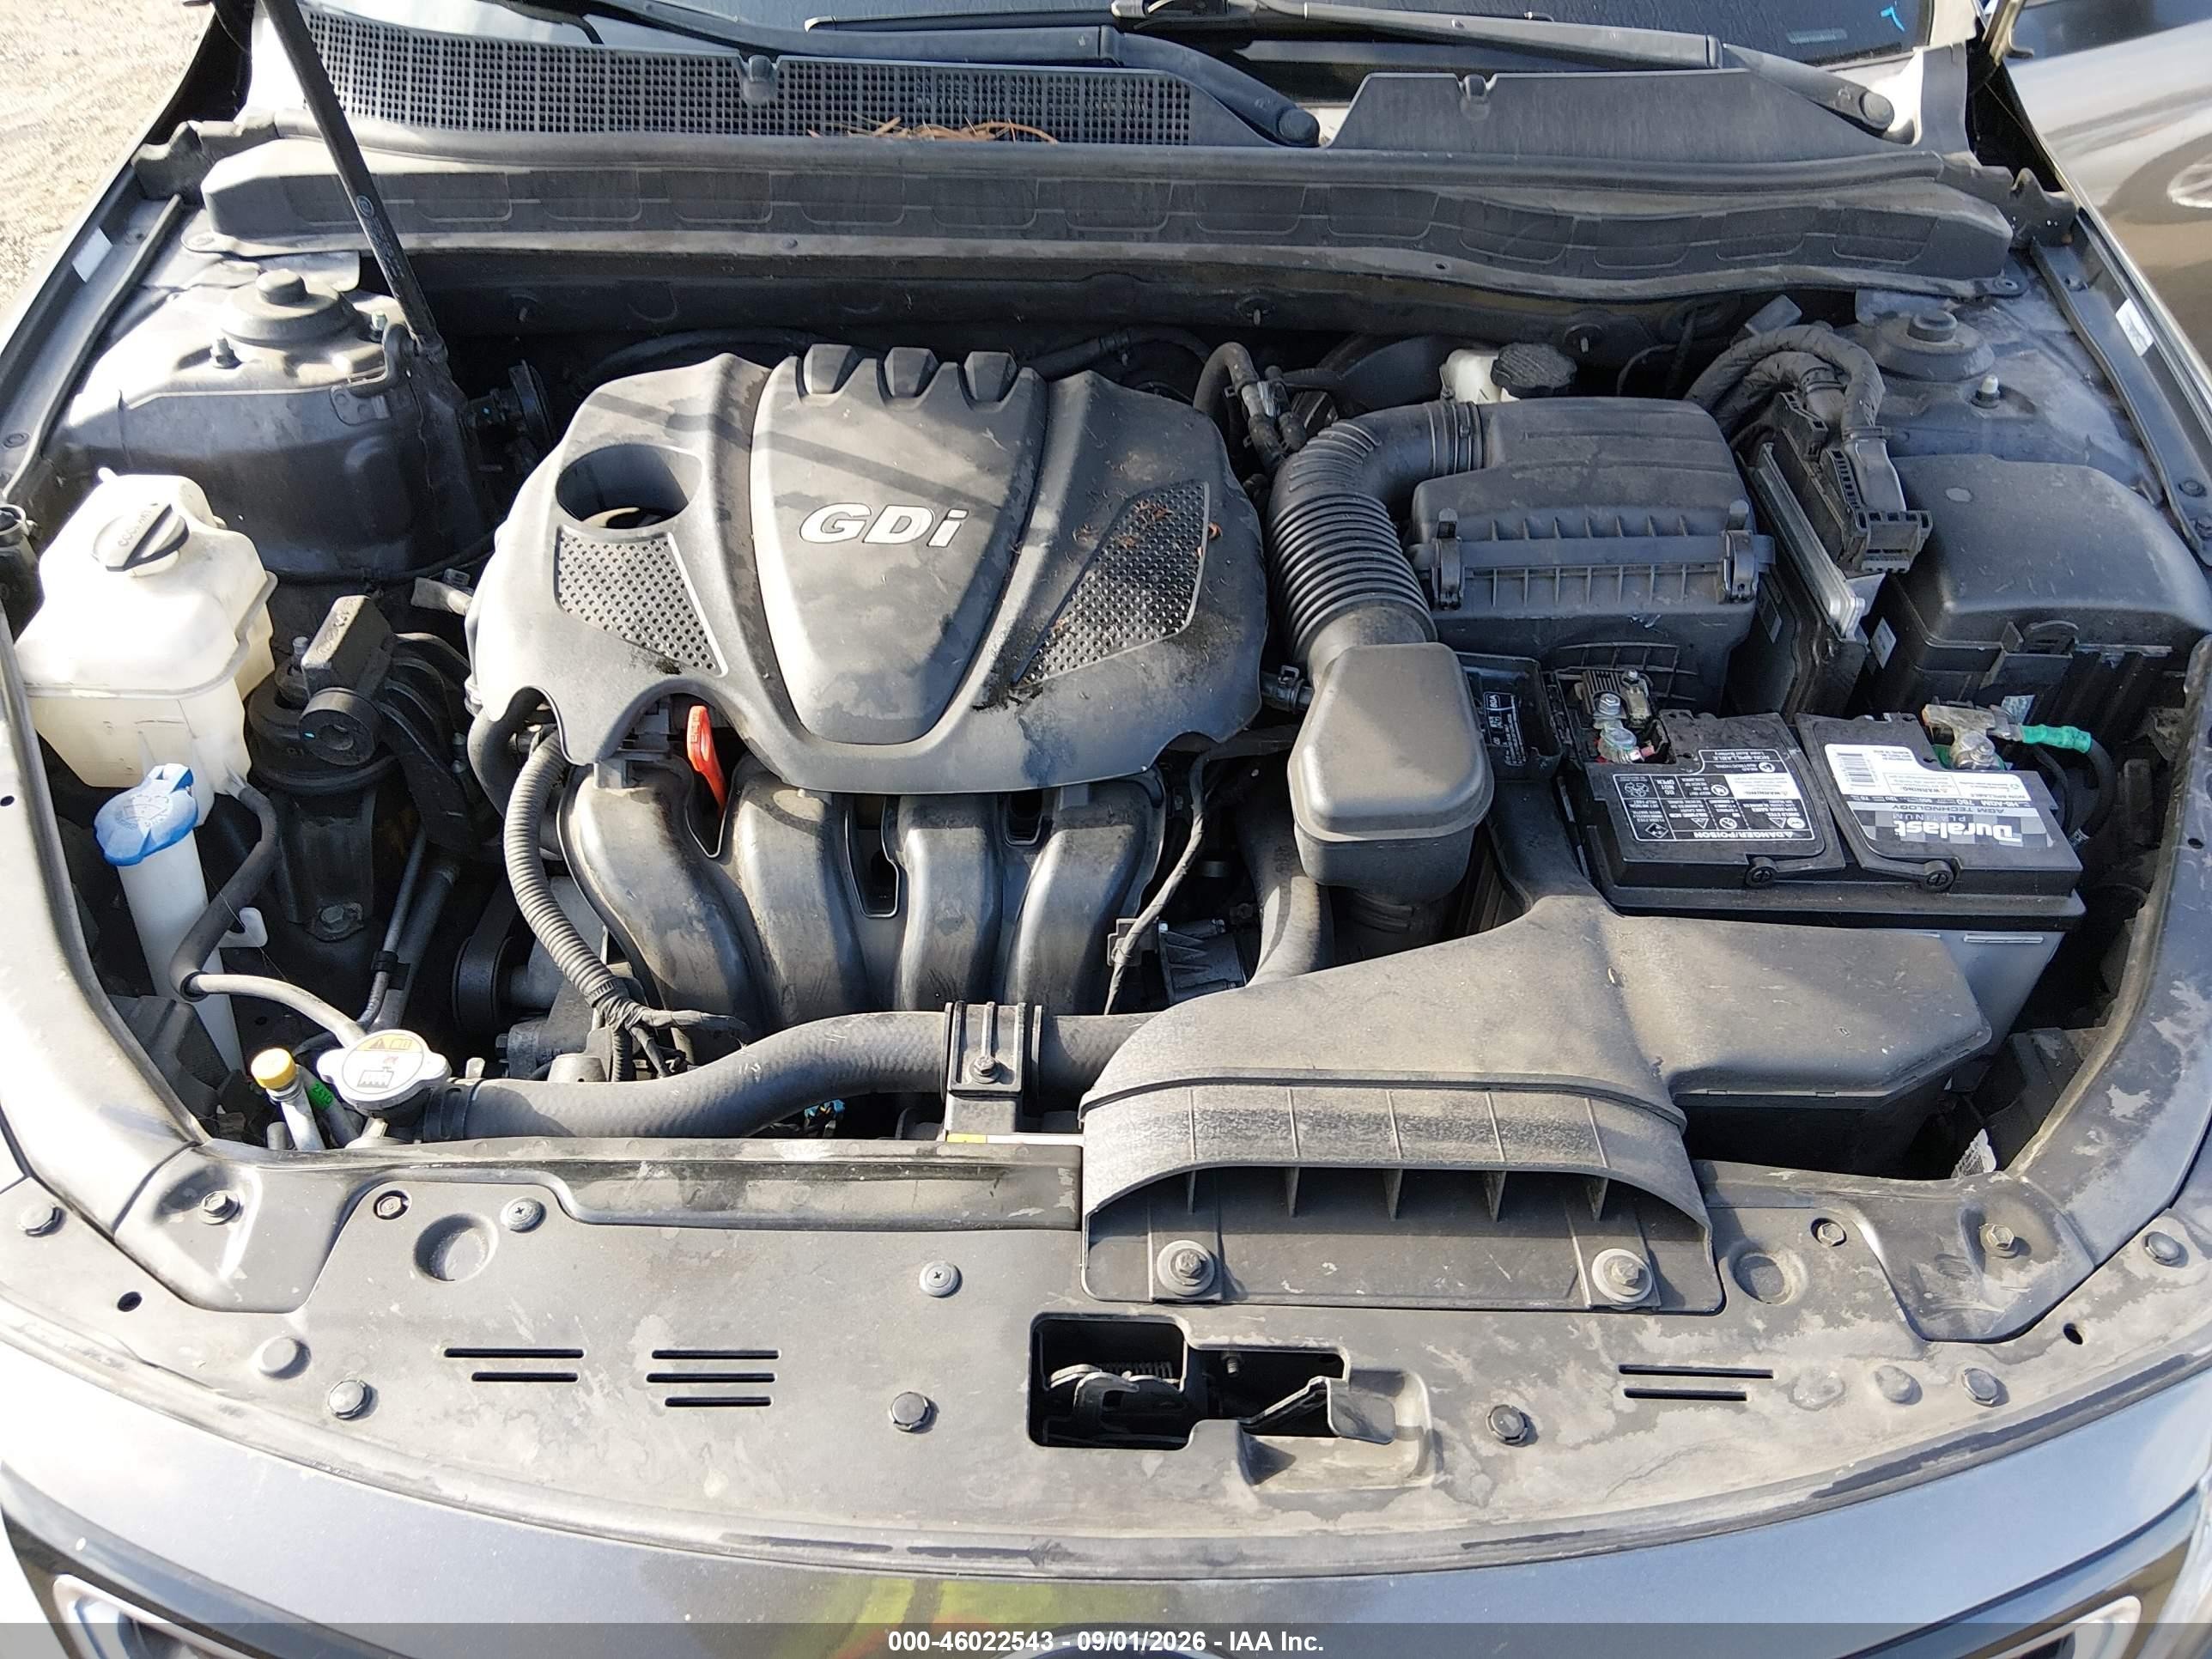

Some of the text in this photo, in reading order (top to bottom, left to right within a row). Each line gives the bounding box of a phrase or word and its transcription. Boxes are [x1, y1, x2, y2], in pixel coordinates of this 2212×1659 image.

[799, 502, 969, 548] GDi
[1892, 812, 1966, 822] PLATINUM
[1893, 820, 2023, 842] Duralast
